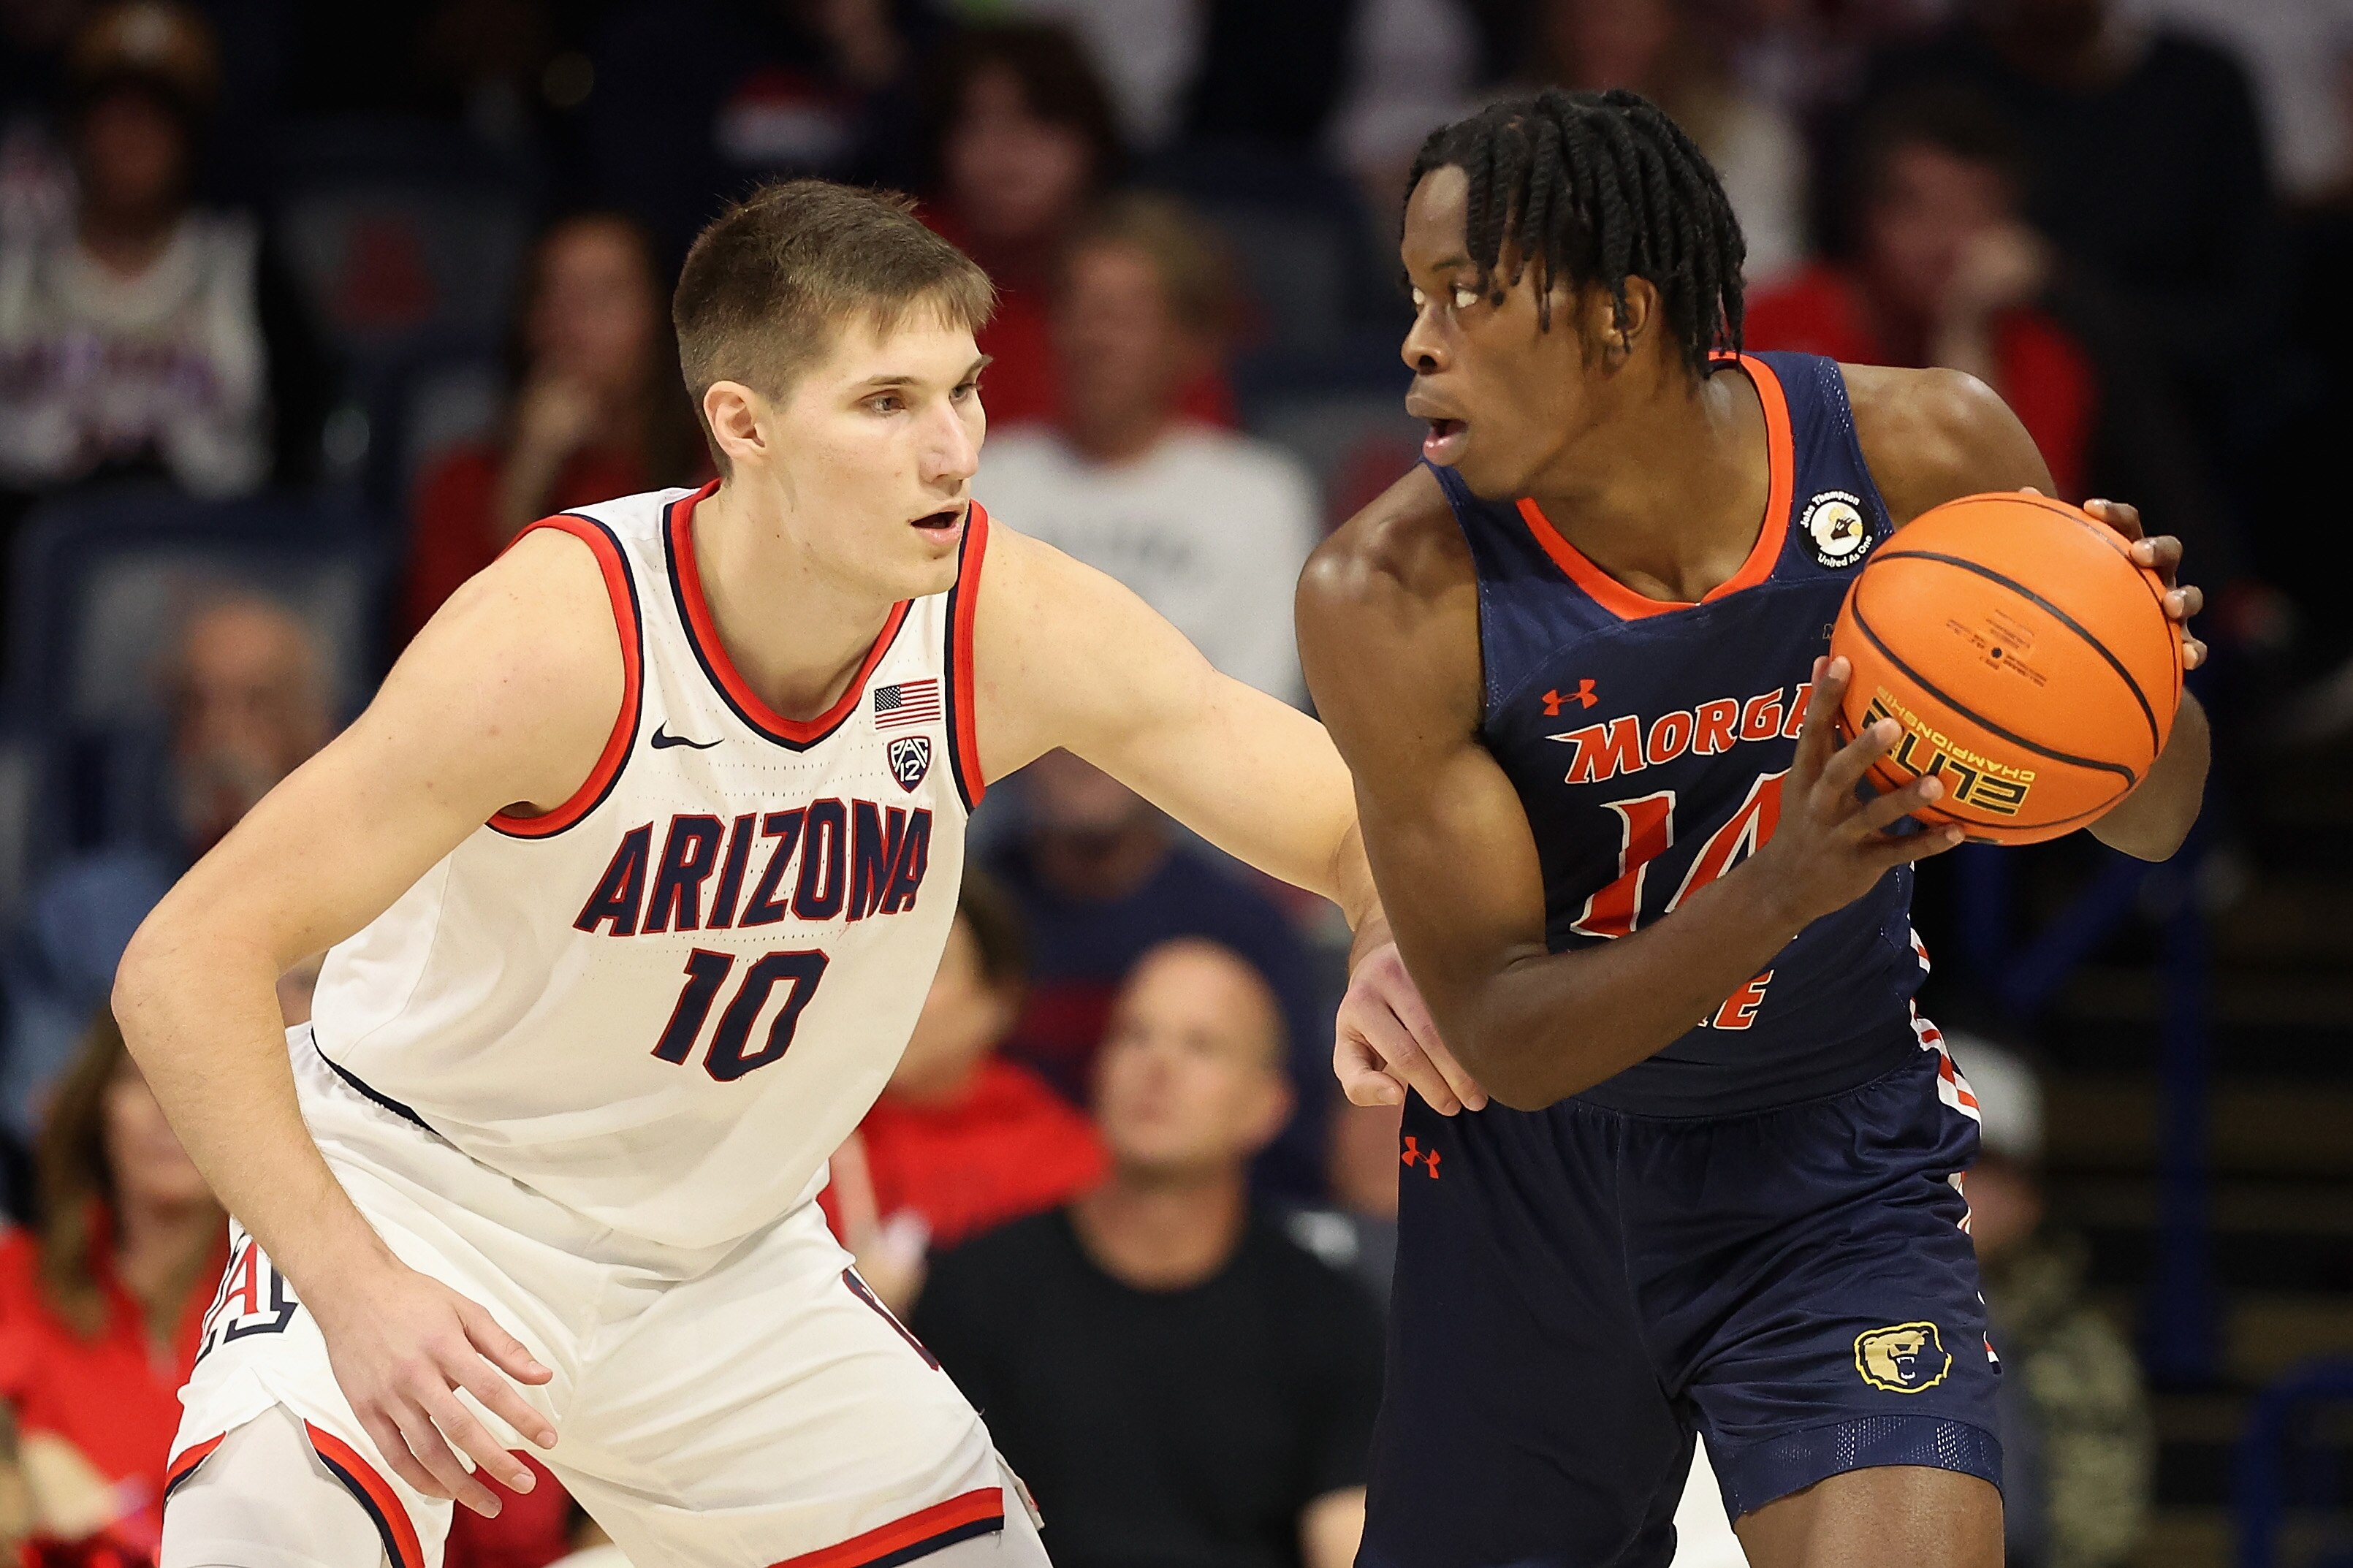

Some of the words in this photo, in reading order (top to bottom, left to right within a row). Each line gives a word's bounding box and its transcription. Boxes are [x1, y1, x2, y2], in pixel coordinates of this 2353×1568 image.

[1801, 505, 1816, 528] John
[1812, 491, 1860, 506] Thompson
[1817, 552, 1848, 568] United
[1849, 552, 1860, 563] As
[1858, 535, 1873, 555] One
[890, 738, 928, 773] PAC
[1546, 683, 1814, 784] MORGA
[1877, 685, 2036, 783] CHAMPIONSHIP
[900, 759, 921, 783] 12
[573, 797, 933, 937] ARIZONA
[650, 947, 830, 1082] 10
